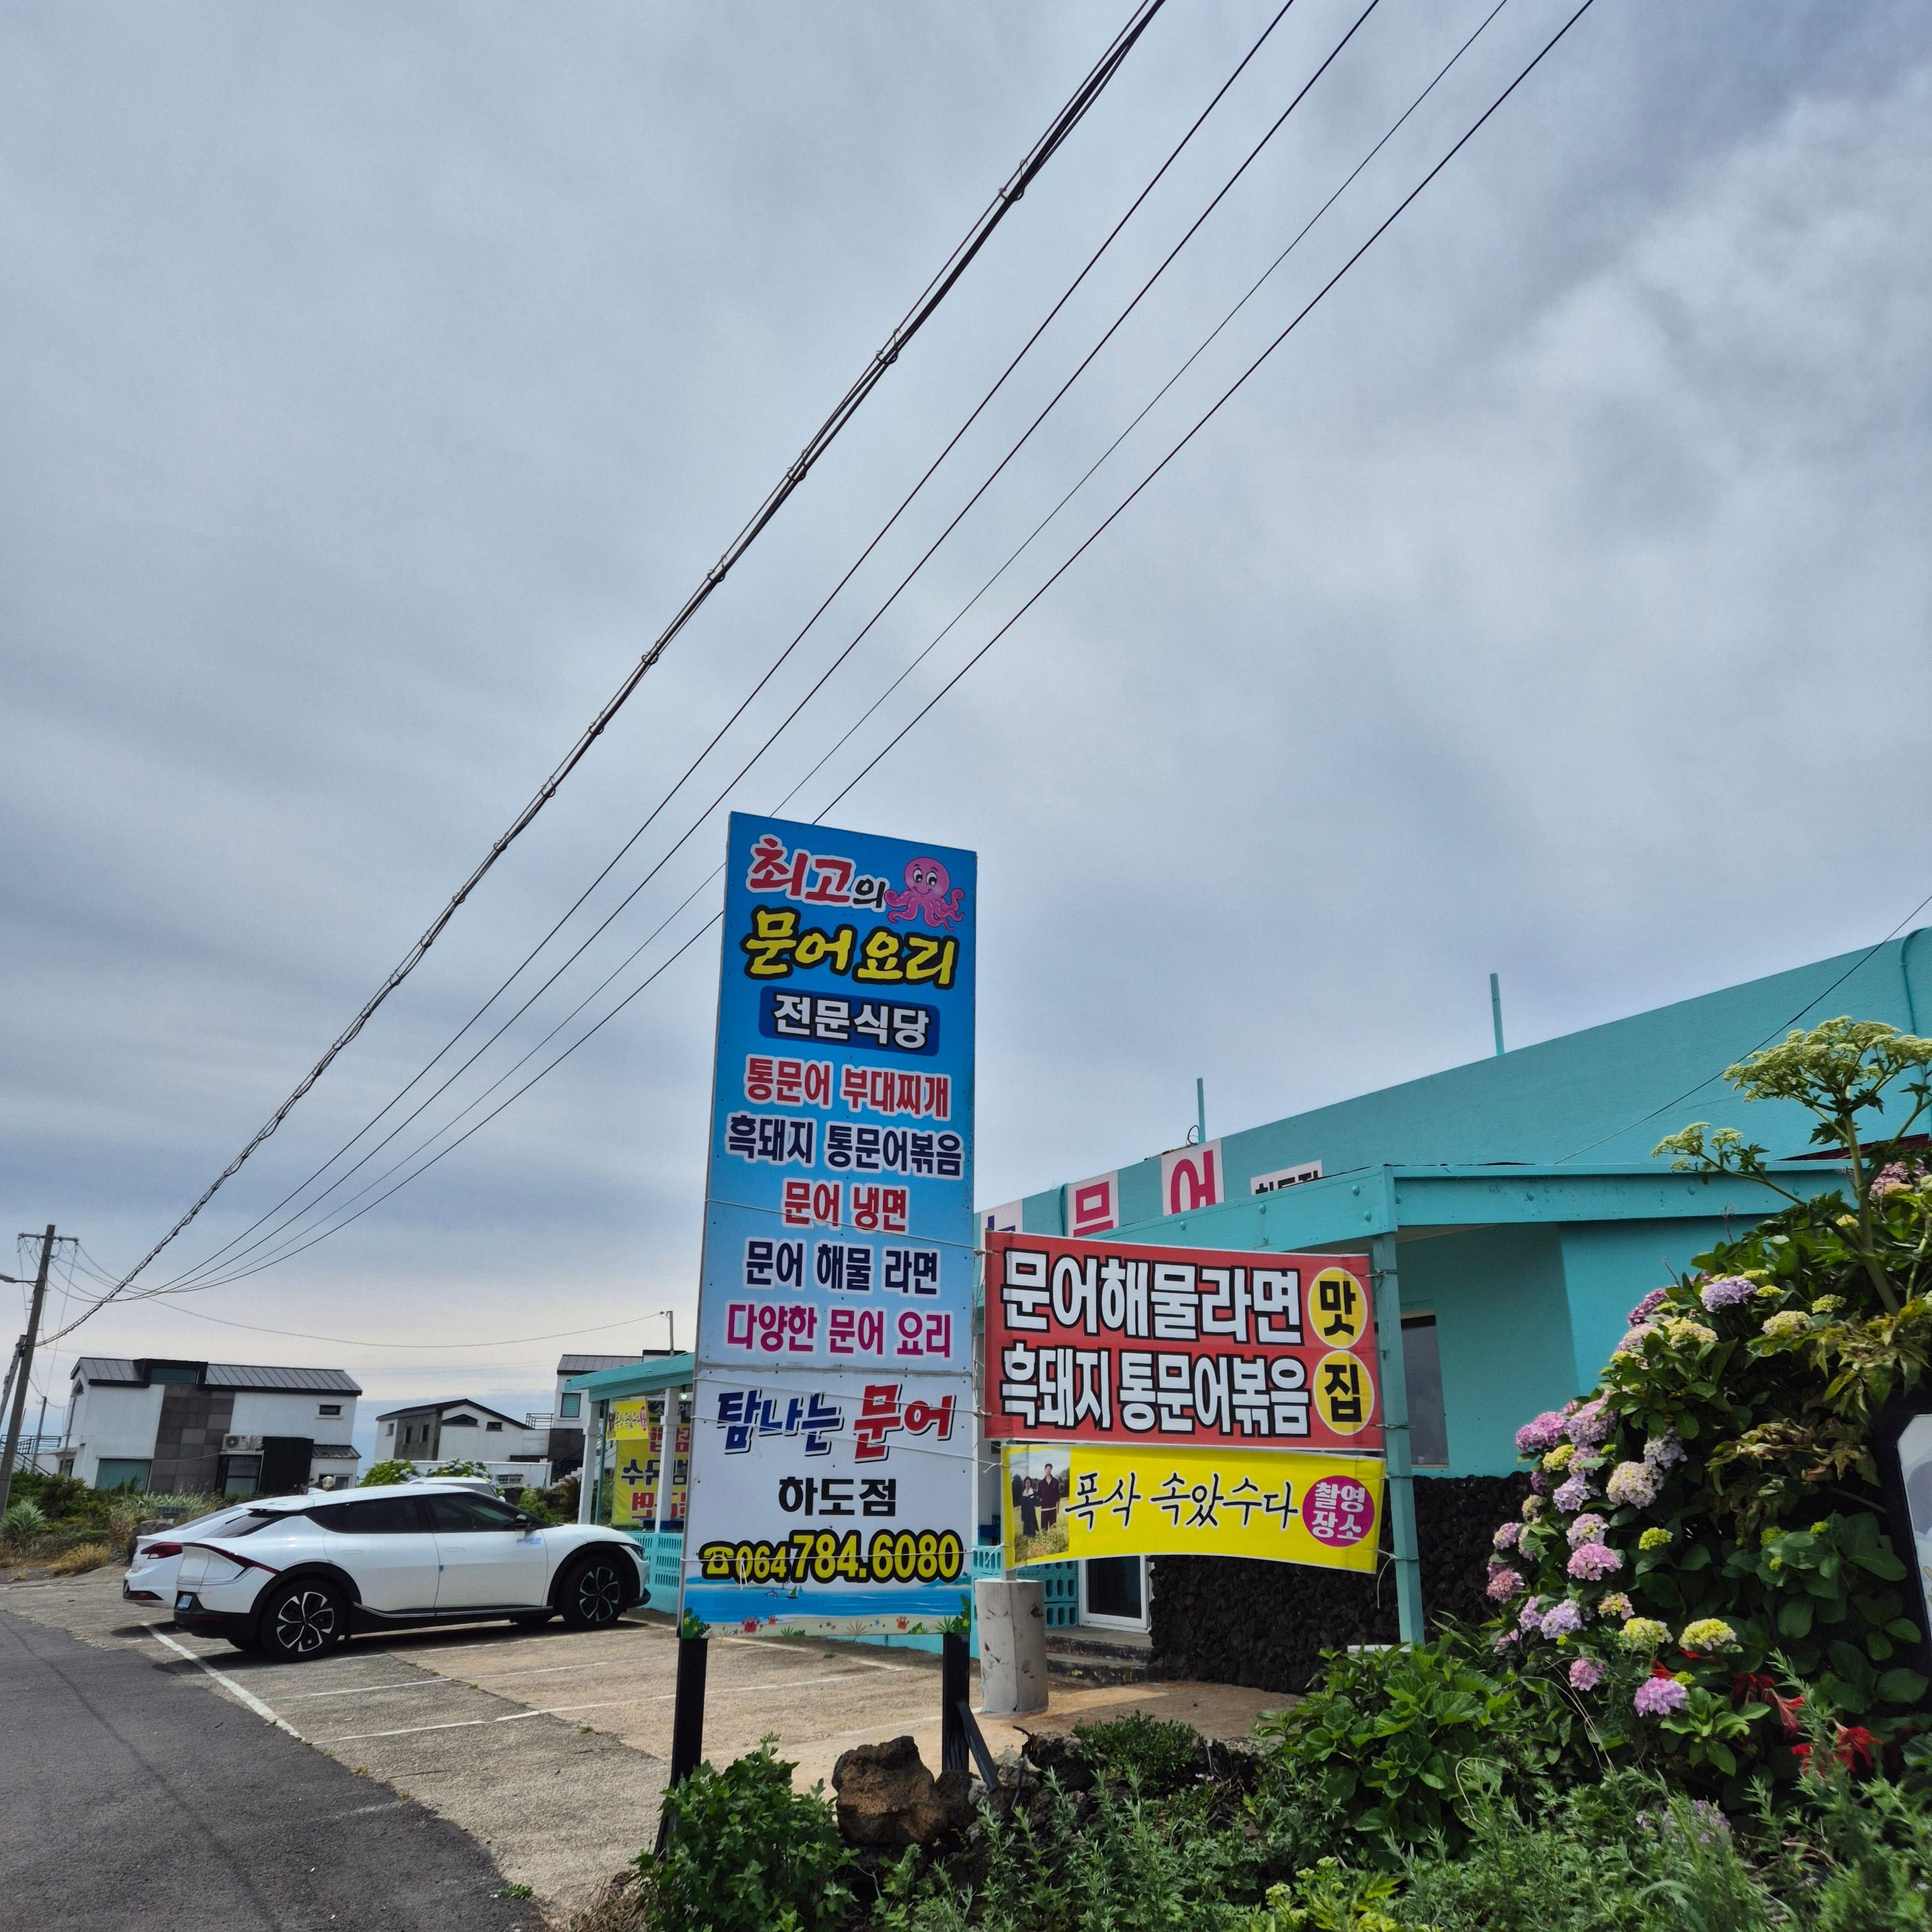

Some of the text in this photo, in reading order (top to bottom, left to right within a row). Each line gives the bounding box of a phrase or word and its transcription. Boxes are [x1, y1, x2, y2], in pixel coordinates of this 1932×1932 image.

[749, 837, 886, 909] 최고의
[774, 994, 930, 1049] 전문식당
[746, 1057, 949, 1118] 통문어 부대찌개
[728, 1114, 963, 1177] 흑돼지 통문어볶음
[784, 1181, 907, 1232] 문어 냉면
[746, 1240, 938, 1295] 문어 해물 라면
[726, 1303, 951, 1359] 다양한 문어 요리
[1001, 1342, 1311, 1437] 흑돼지 통문어볶음
[717, 1383, 956, 1462] 탐나는 문어
[777, 1475, 897, 1517] 하도점
[1065, 1471, 1299, 1530] 폭삭 속았수다
[1314, 1482, 1366, 1513] 촬영
[1311, 1510, 1364, 1541] 장소
